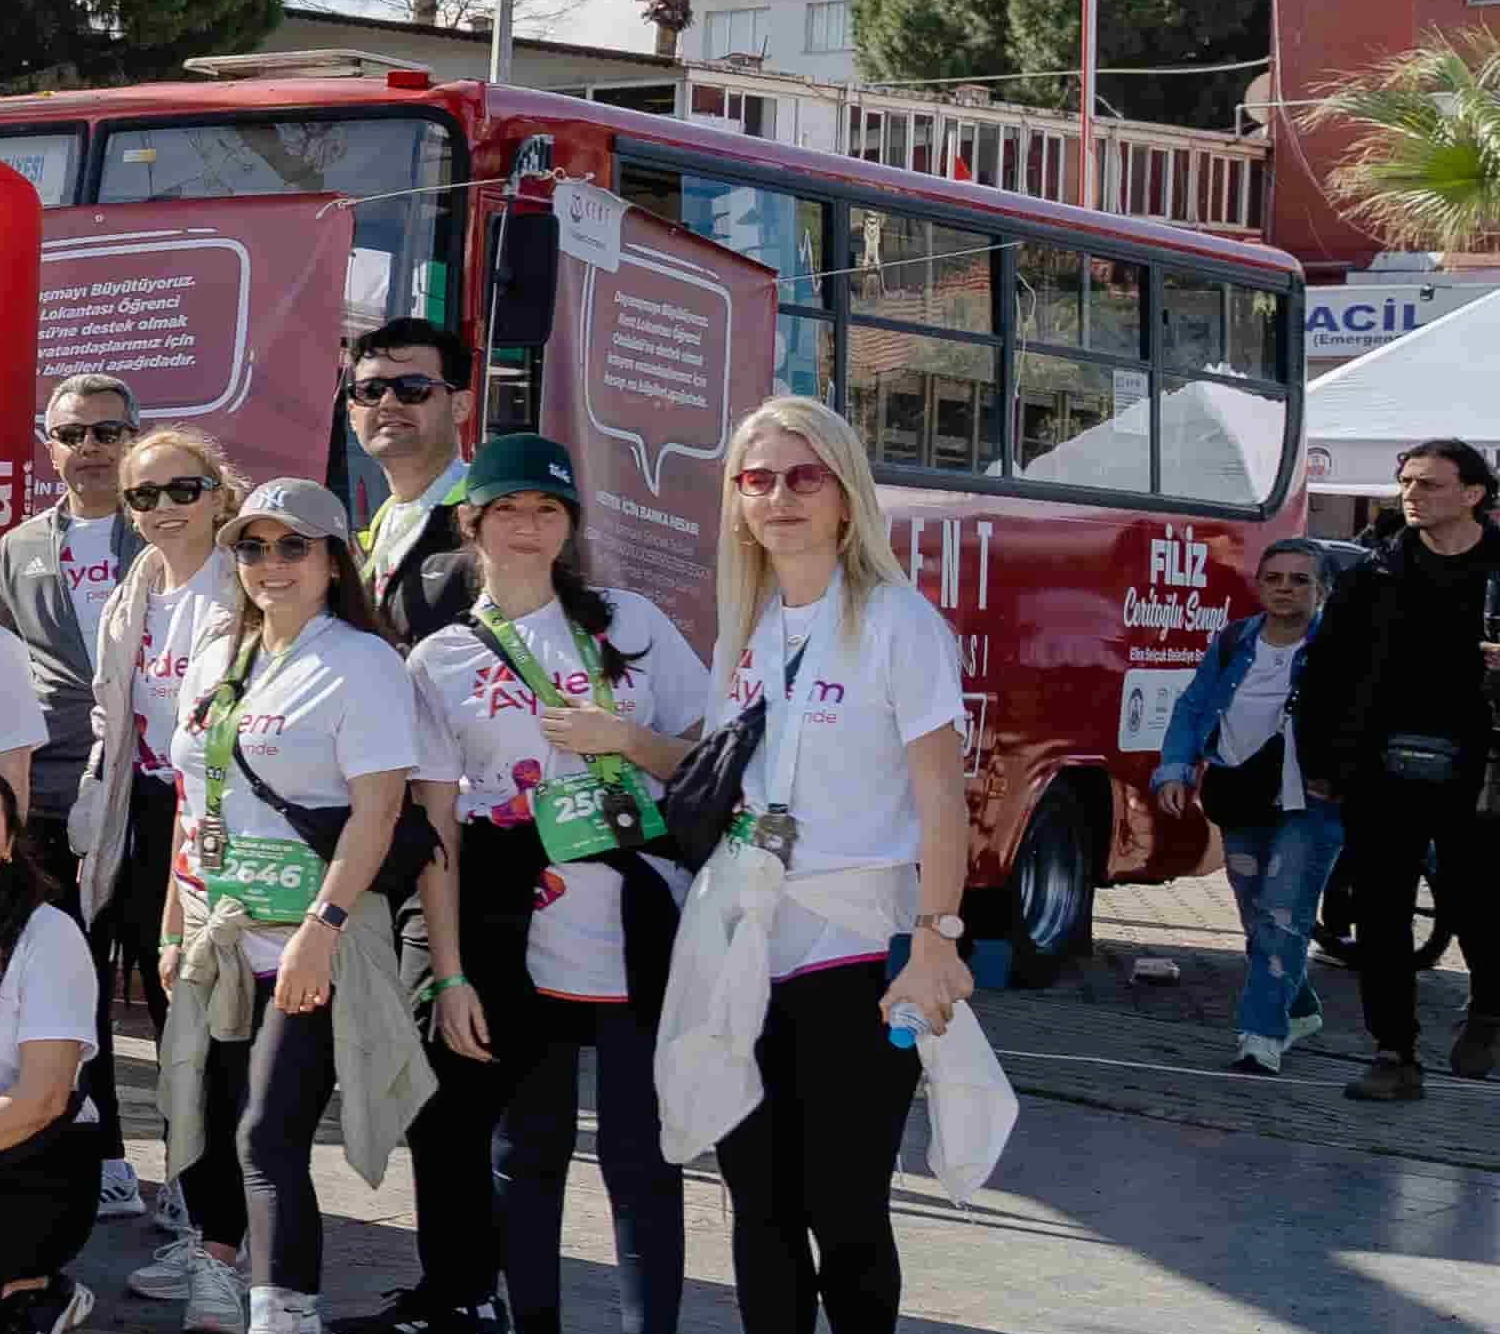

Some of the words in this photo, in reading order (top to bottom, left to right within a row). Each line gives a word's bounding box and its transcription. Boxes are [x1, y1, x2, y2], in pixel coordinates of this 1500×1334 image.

[138, 315, 188, 333] olmak
[1306, 298, 1422, 332] ACİL
[885, 516, 993, 610] ENT
[1150, 523, 1208, 588] FİLİZ
[222, 856, 305, 889] 2646
